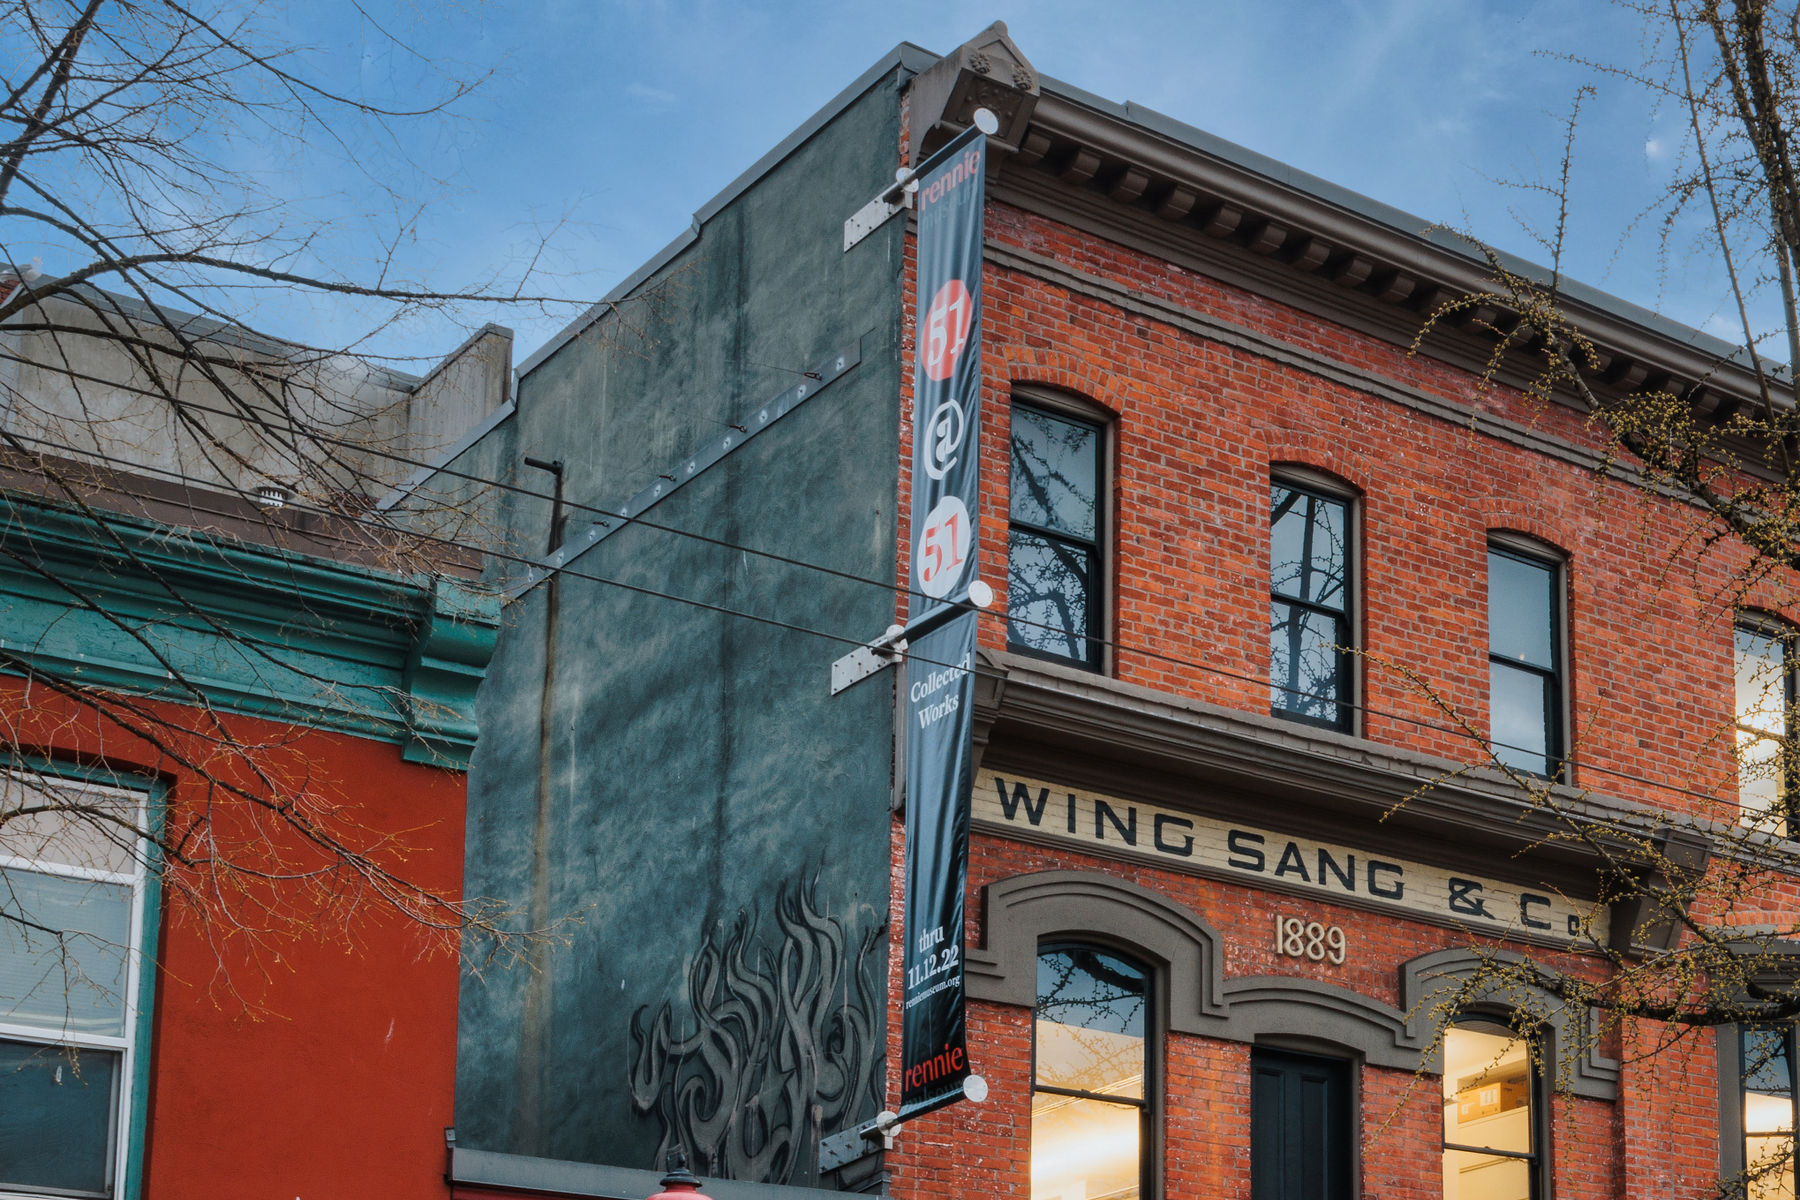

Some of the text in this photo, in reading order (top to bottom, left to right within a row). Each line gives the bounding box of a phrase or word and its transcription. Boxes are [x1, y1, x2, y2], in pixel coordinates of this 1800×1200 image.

[921, 150, 980, 211] rennie
[926, 297, 966, 368] 51
[922, 511, 964, 584] 51
[910, 653, 972, 704] Collected
[918, 695, 960, 730] Works
[994, 778, 1195, 856] WING
[1227, 829, 1406, 901] SANG
[1447, 876, 1496, 919] &
[918, 925, 945, 954] thru
[1274, 914, 1347, 965] 1889
[905, 975, 961, 1010] renniemuseum.org
[907, 944, 960, 990] 11.12.22
[904, 1043, 964, 1092] rennie
